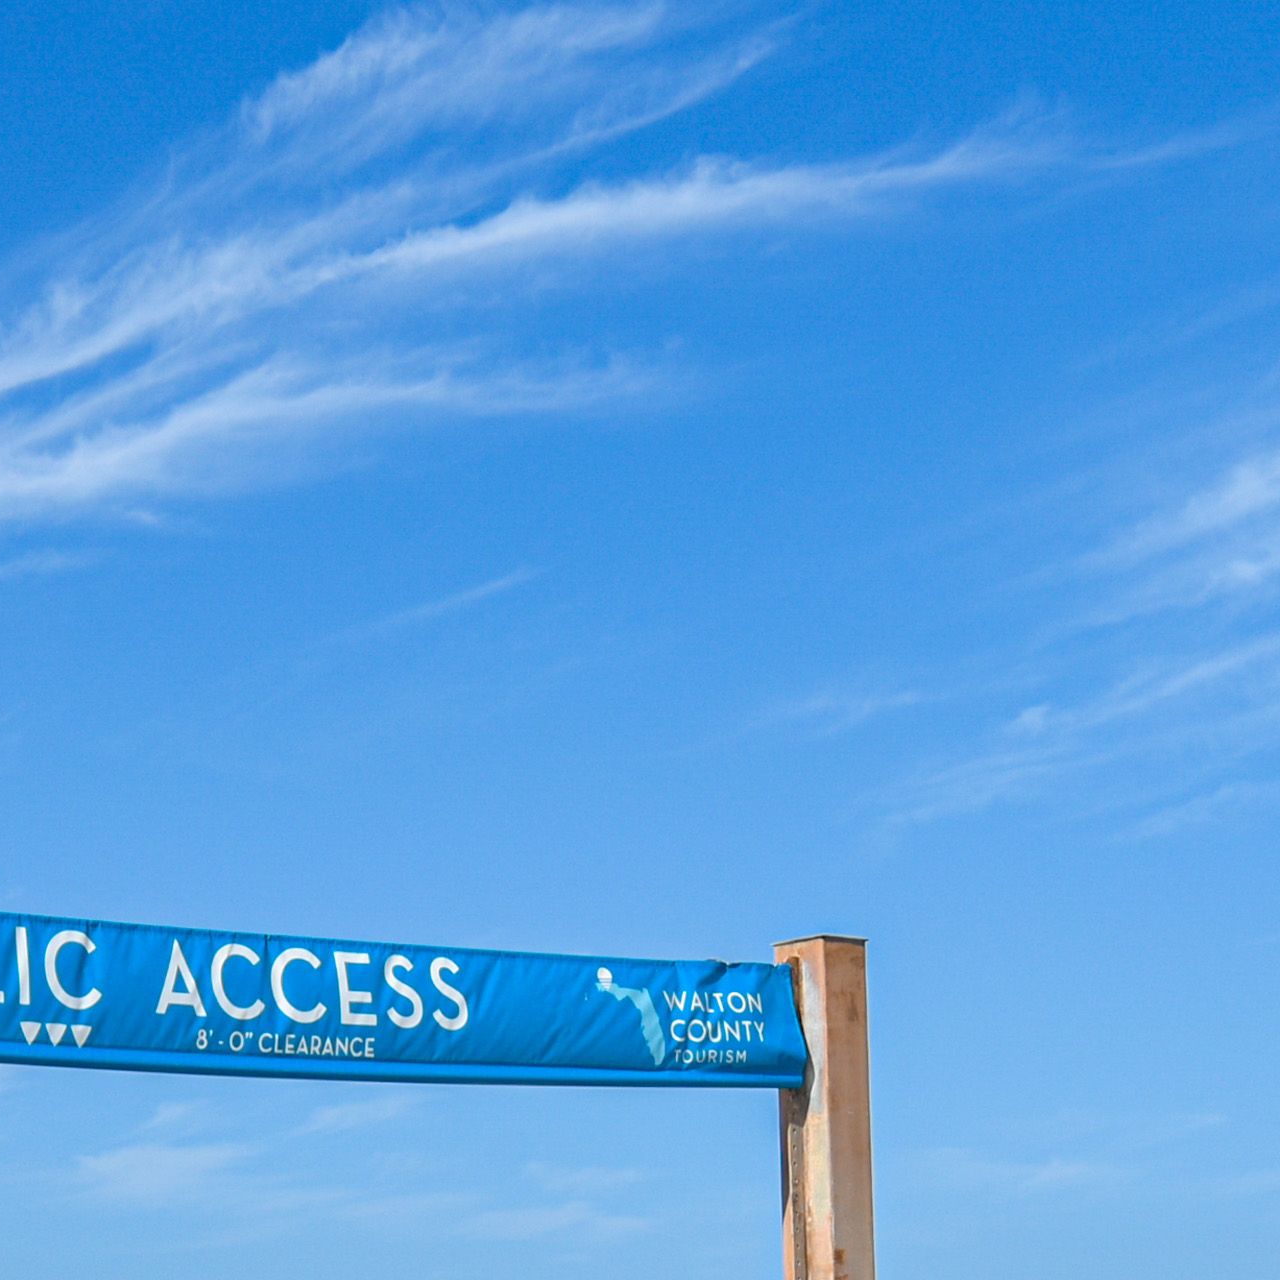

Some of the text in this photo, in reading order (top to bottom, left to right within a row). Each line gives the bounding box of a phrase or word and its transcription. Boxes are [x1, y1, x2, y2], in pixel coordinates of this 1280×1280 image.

[154, 939, 469, 1031] ACCESS
[662, 990, 763, 1014] WALTON
[670, 1019, 765, 1043] COUNTY
[258, 1032, 376, 1058] CLEARANCE
[674, 1048, 748, 1064] TOURISM
